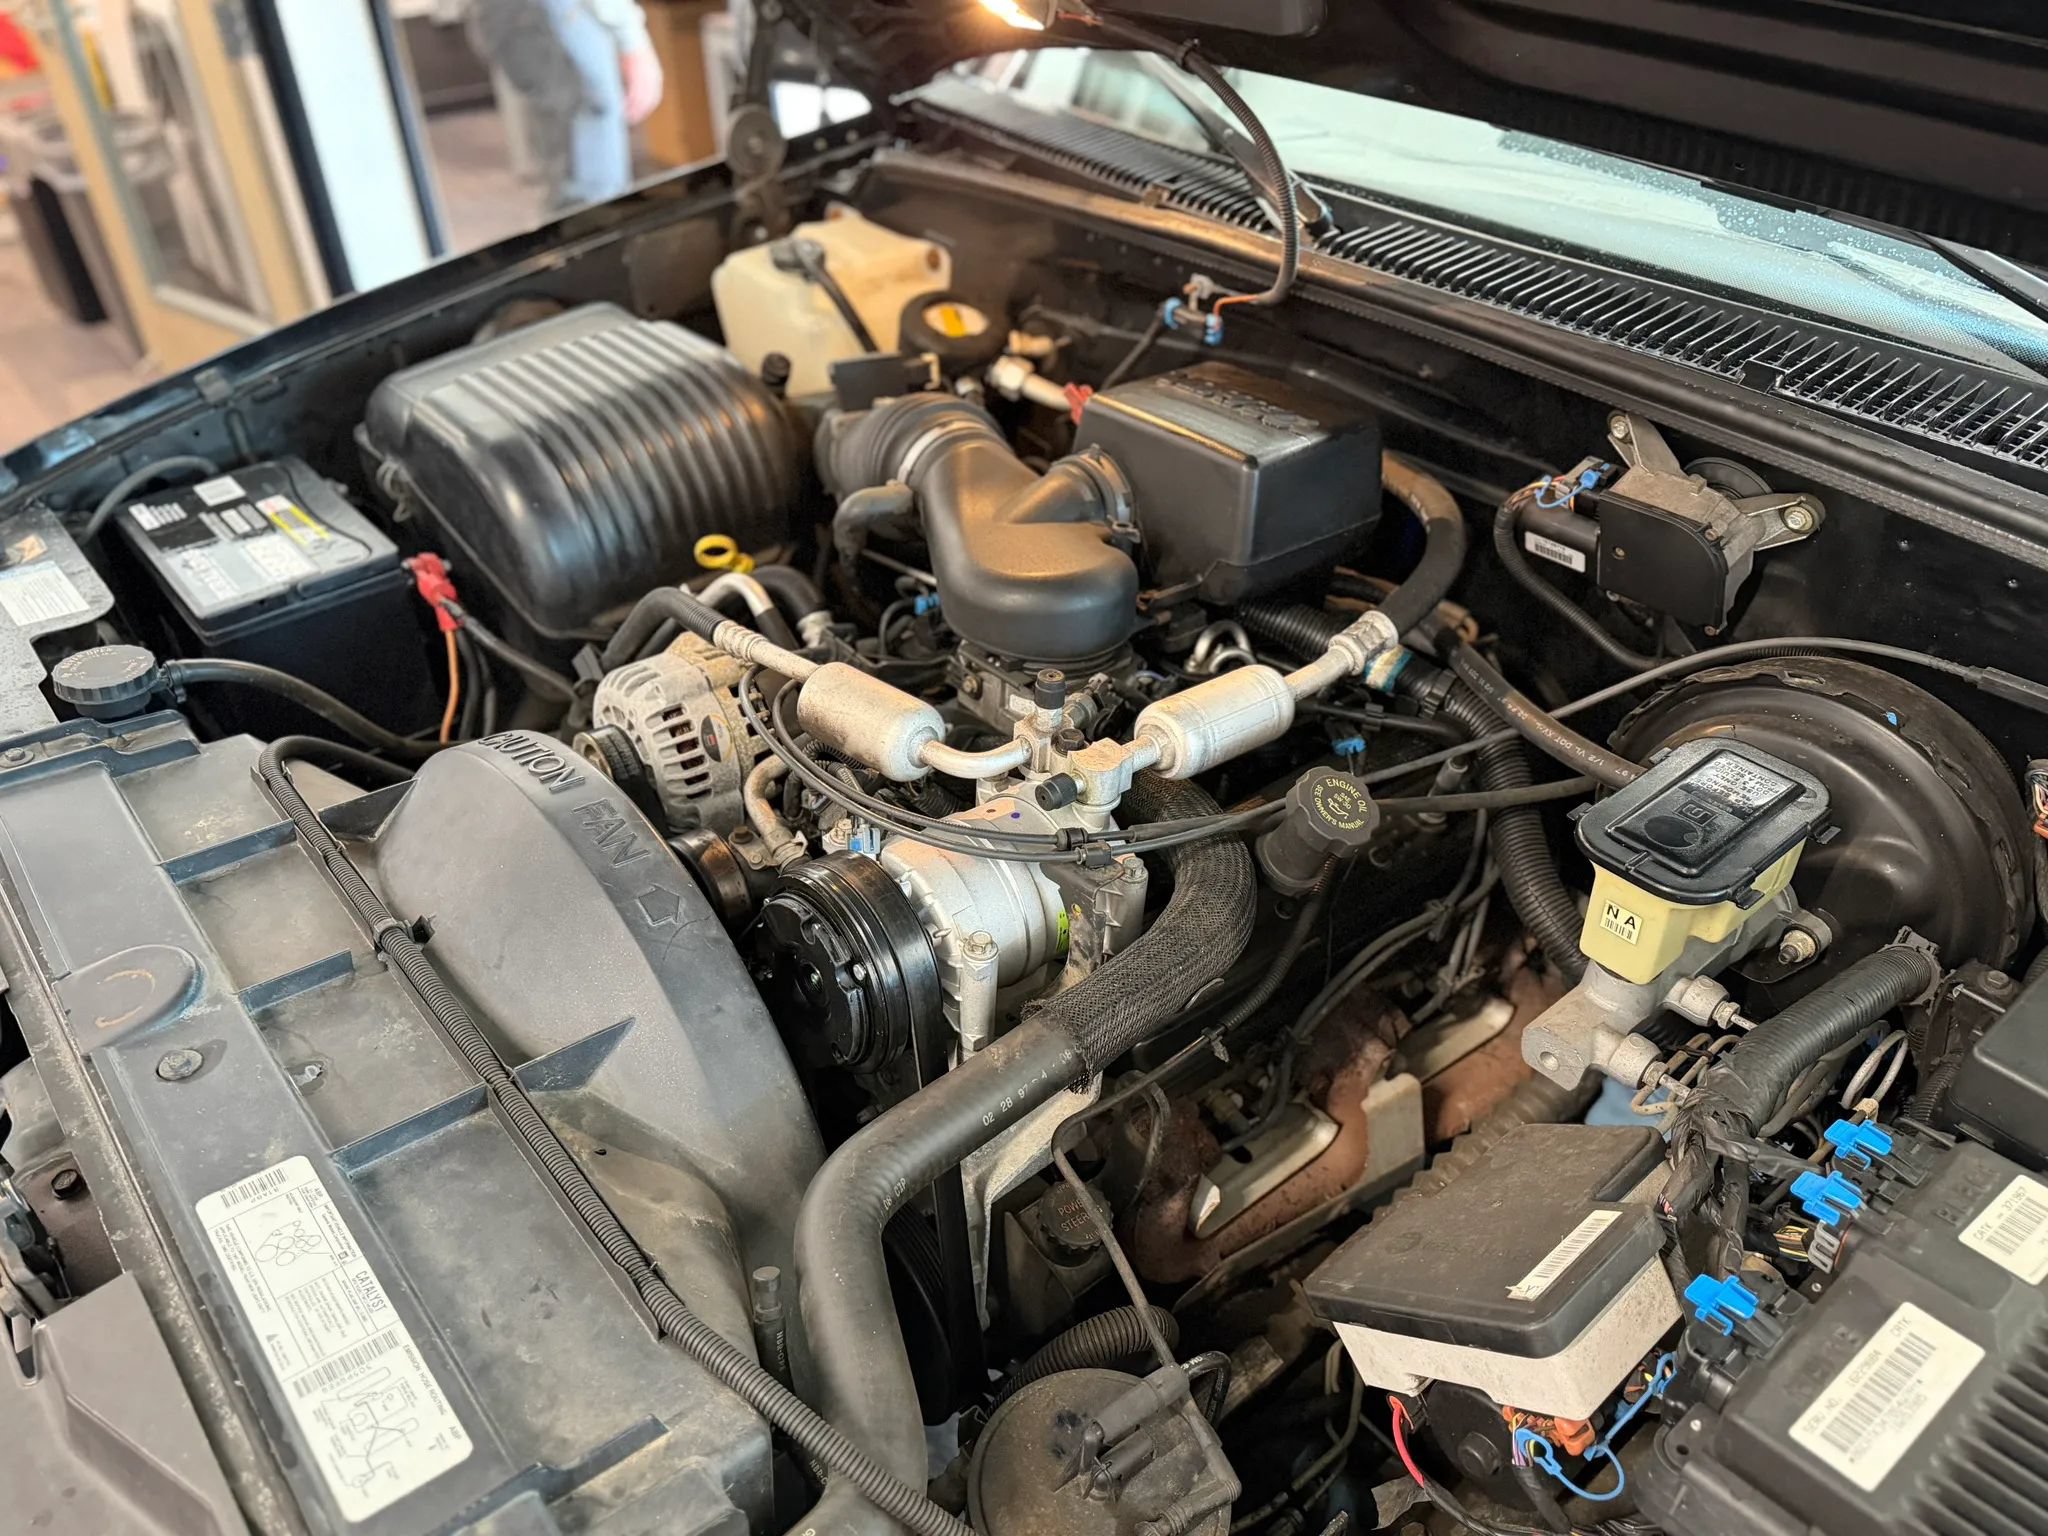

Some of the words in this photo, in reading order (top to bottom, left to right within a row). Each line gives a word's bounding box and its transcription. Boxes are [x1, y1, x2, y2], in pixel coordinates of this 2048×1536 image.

[1553, 734, 1573, 749] DOT
[1713, 761, 1746, 777] SEALED
[1714, 767, 1741, 781] FLUID
[1711, 772, 1738, 786] ONLY
[1753, 780, 1780, 793] FROM
[1314, 784, 1324, 797] SEE
[1326, 778, 1361, 799] ENGINE
[1358, 799, 1367, 813] OIL
[1340, 792, 1352, 802] SAE
[1704, 777, 1753, 801] REMOVING
[1739, 785, 1760, 796] USE
[1749, 784, 1770, 794] DOT
[478, 733, 586, 792] CAUTION
[571, 798, 651, 868] FAN
[1314, 797, 1337, 826] OWNER'S
[1339, 818, 1365, 829] MANUAL
[1607, 904, 1619, 919] N
[1624, 916, 1635, 929] A
[983, 1112, 995, 1126] 02
[1000, 1097, 1013, 1112] 28
[1018, 1083, 1028, 1099] 97
[1057, 1199, 1084, 1217] POWE
[354, 1269, 387, 1313] CATALYST
[402, 1343, 422, 1372] EMISSION
[417, 1371, 432, 1389] HOSE
[427, 1387, 447, 1416] ROUTING
